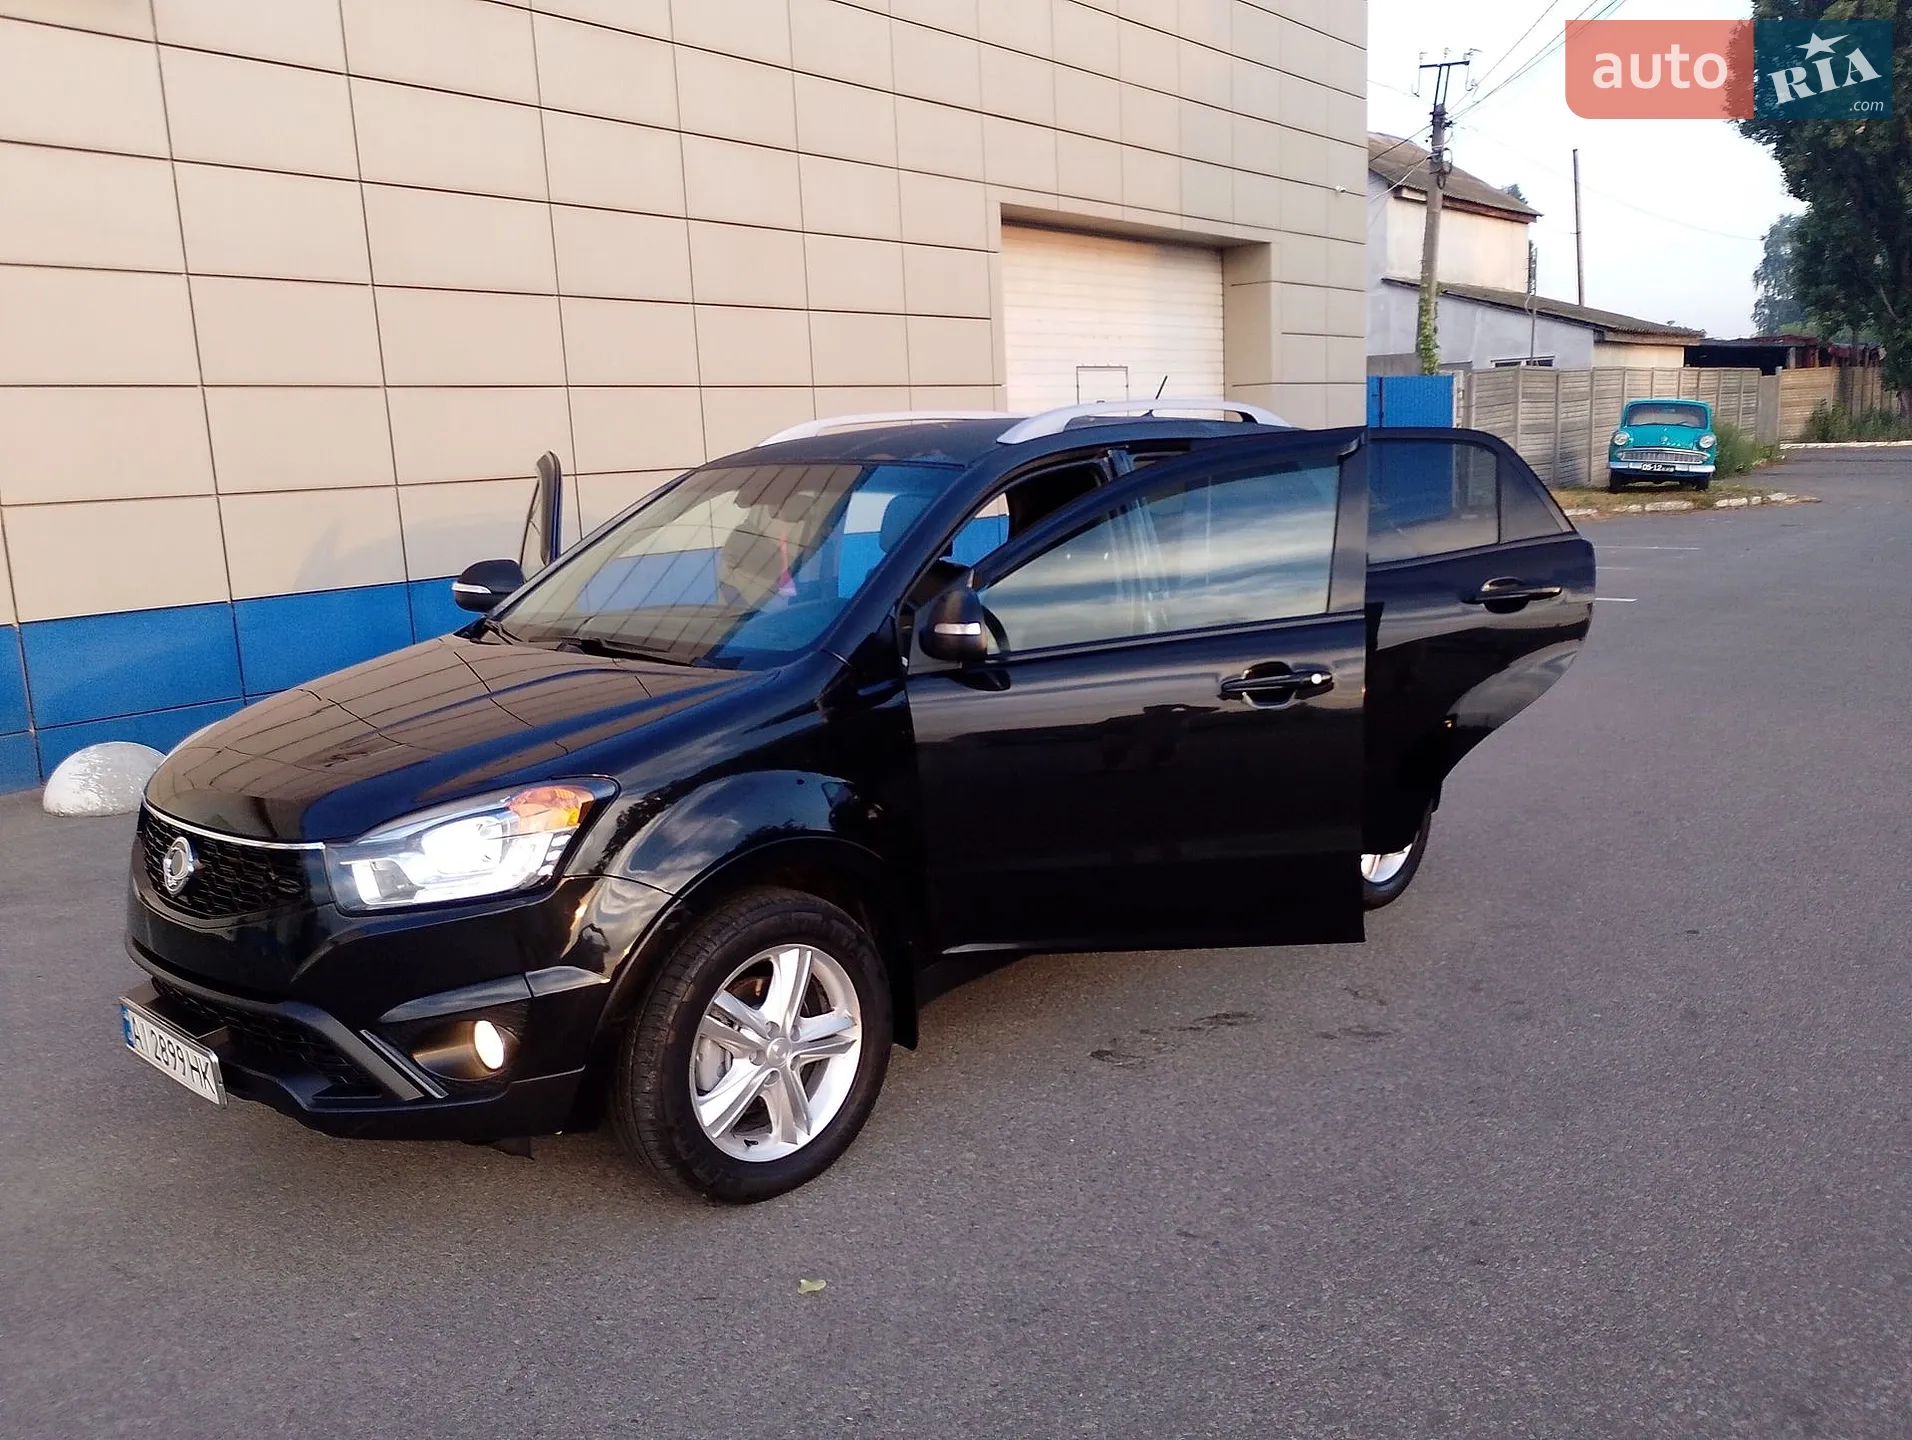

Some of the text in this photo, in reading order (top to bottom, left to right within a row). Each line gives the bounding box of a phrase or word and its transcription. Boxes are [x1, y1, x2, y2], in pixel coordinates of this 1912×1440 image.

[133, 1017, 216, 1095] AI 2899 HK
